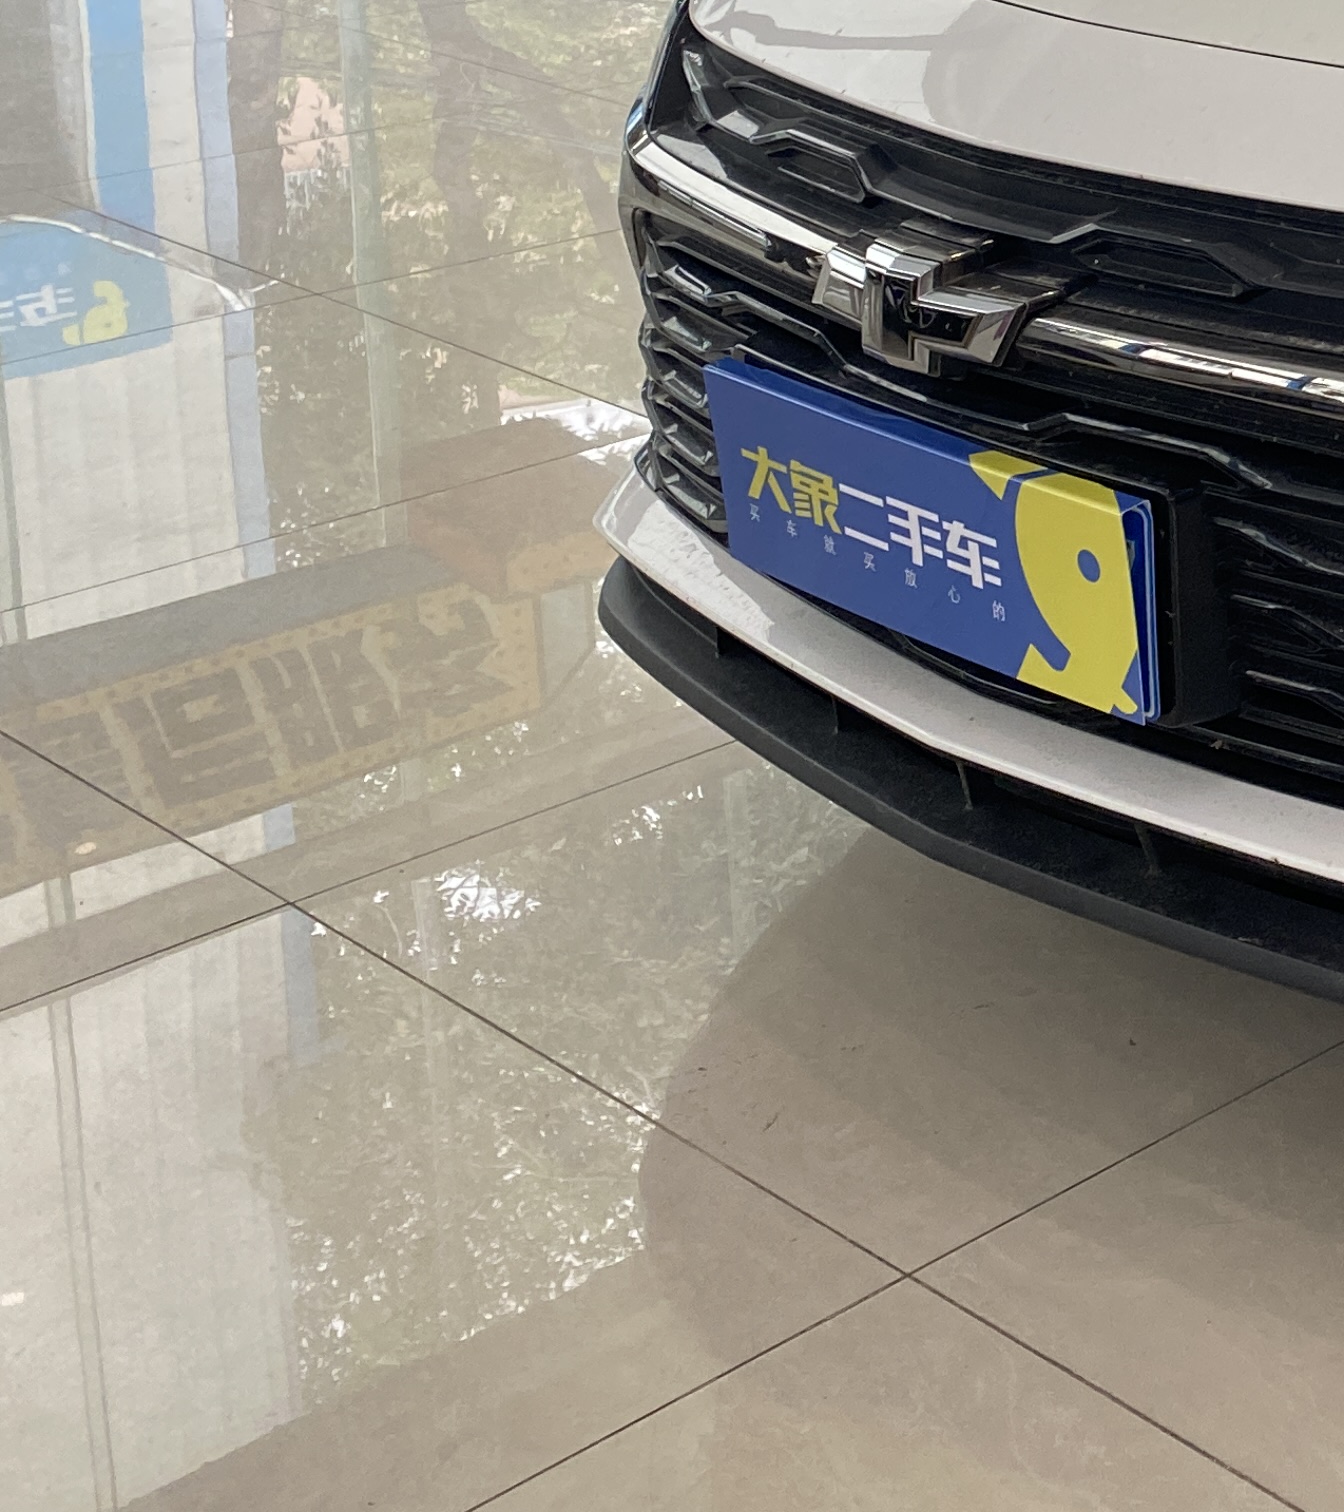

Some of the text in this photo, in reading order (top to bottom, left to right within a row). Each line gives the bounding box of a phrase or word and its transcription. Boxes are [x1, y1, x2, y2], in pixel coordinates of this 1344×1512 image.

[741, 446, 1002, 589] 大象二手车
